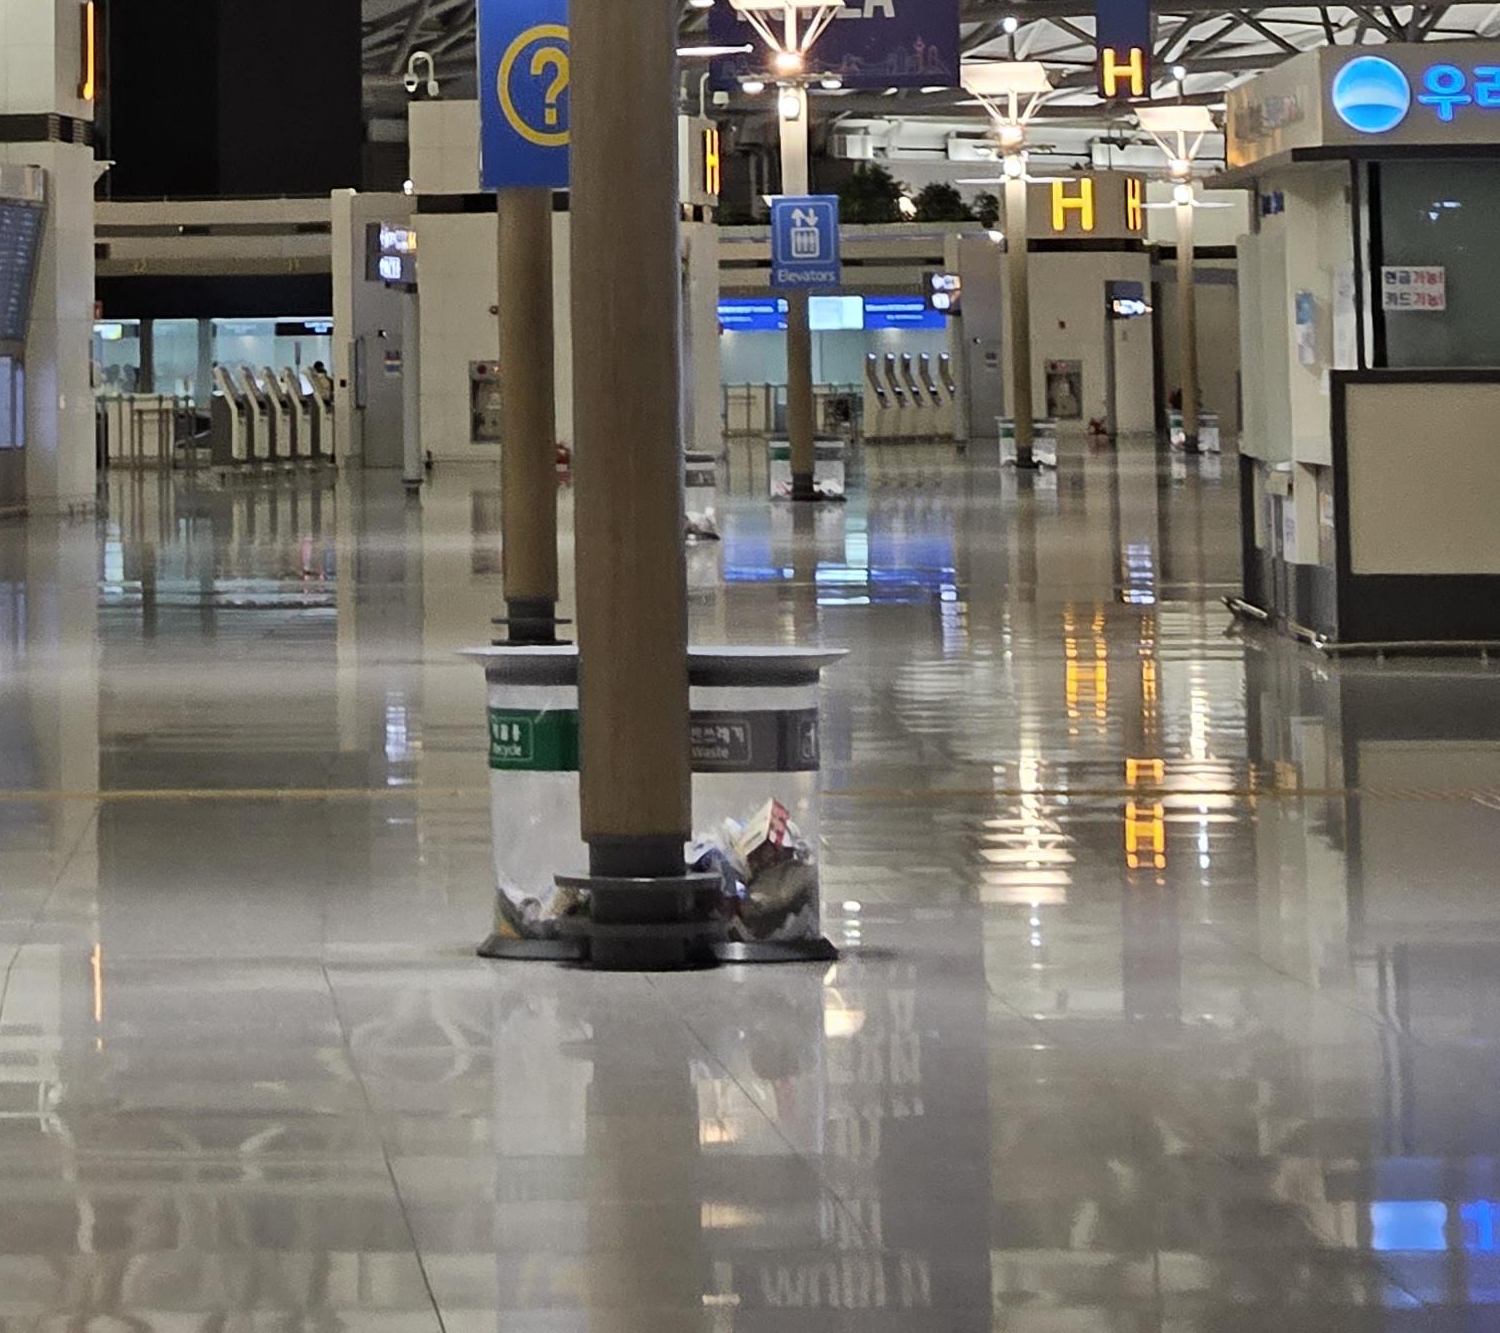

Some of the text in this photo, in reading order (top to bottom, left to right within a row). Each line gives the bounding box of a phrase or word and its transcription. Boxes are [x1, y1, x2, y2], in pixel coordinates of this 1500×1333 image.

[1103, 47, 1143, 97] H
[706, 129, 719, 195] H
[1052, 177, 1093, 231] H
[1127, 178, 1141, 230] H
[777, 268, 837, 283] Elevators
